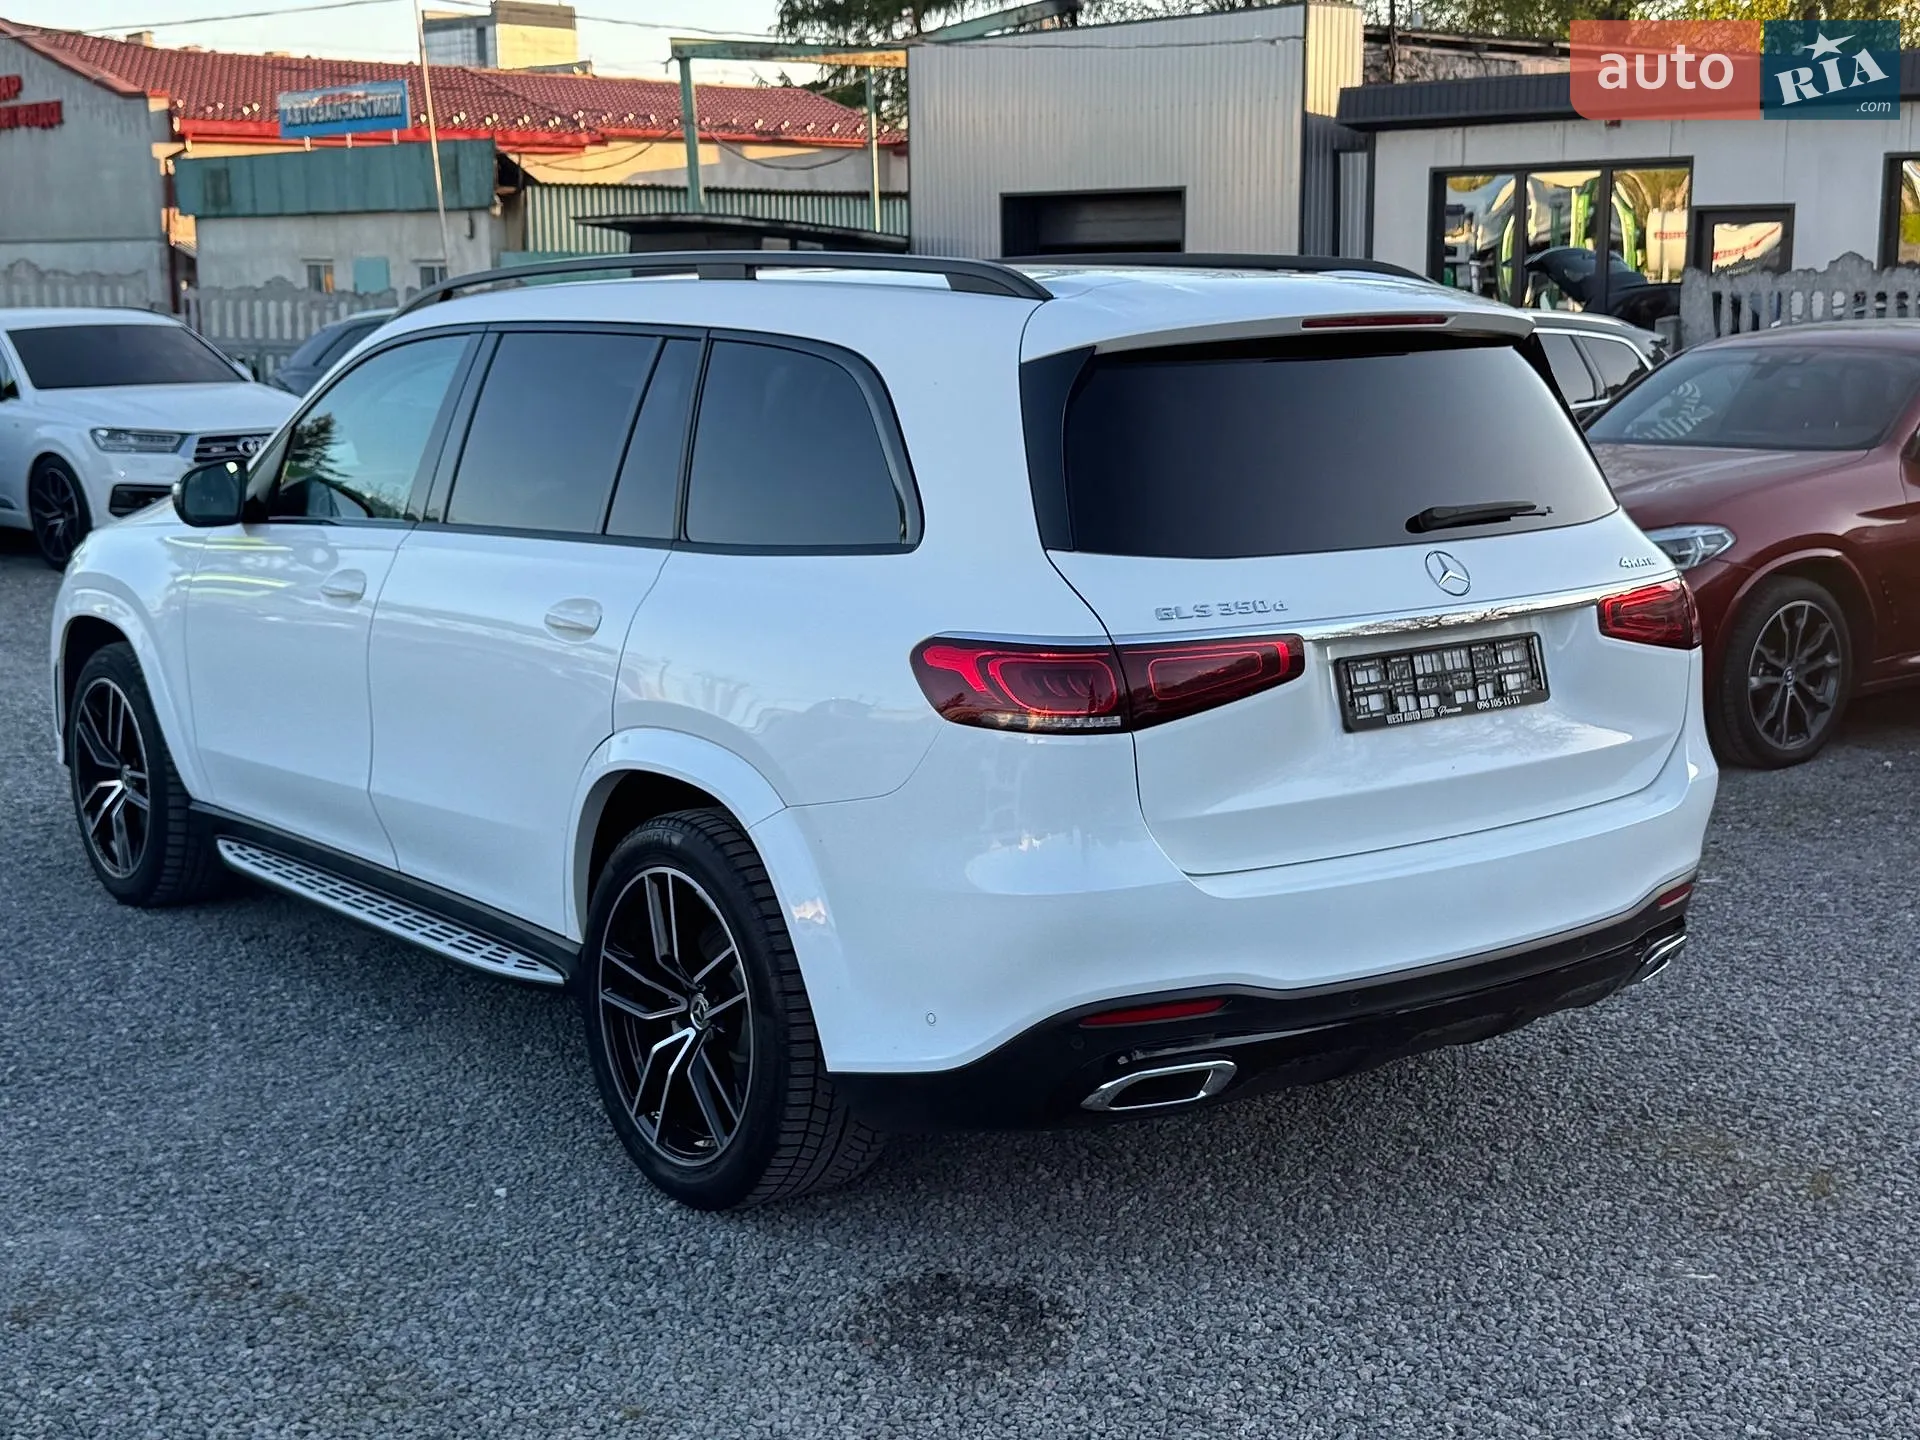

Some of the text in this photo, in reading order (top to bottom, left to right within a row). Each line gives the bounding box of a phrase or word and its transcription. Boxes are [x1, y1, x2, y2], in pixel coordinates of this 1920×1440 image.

[1155, 604, 1213, 621] GLS
[1476, 695, 1520, 710] 096 105-11-11
[1386, 713, 1403, 724] WEST
[1404, 710, 1420, 722] AUTO
[1421, 708, 1435, 719] HUB
